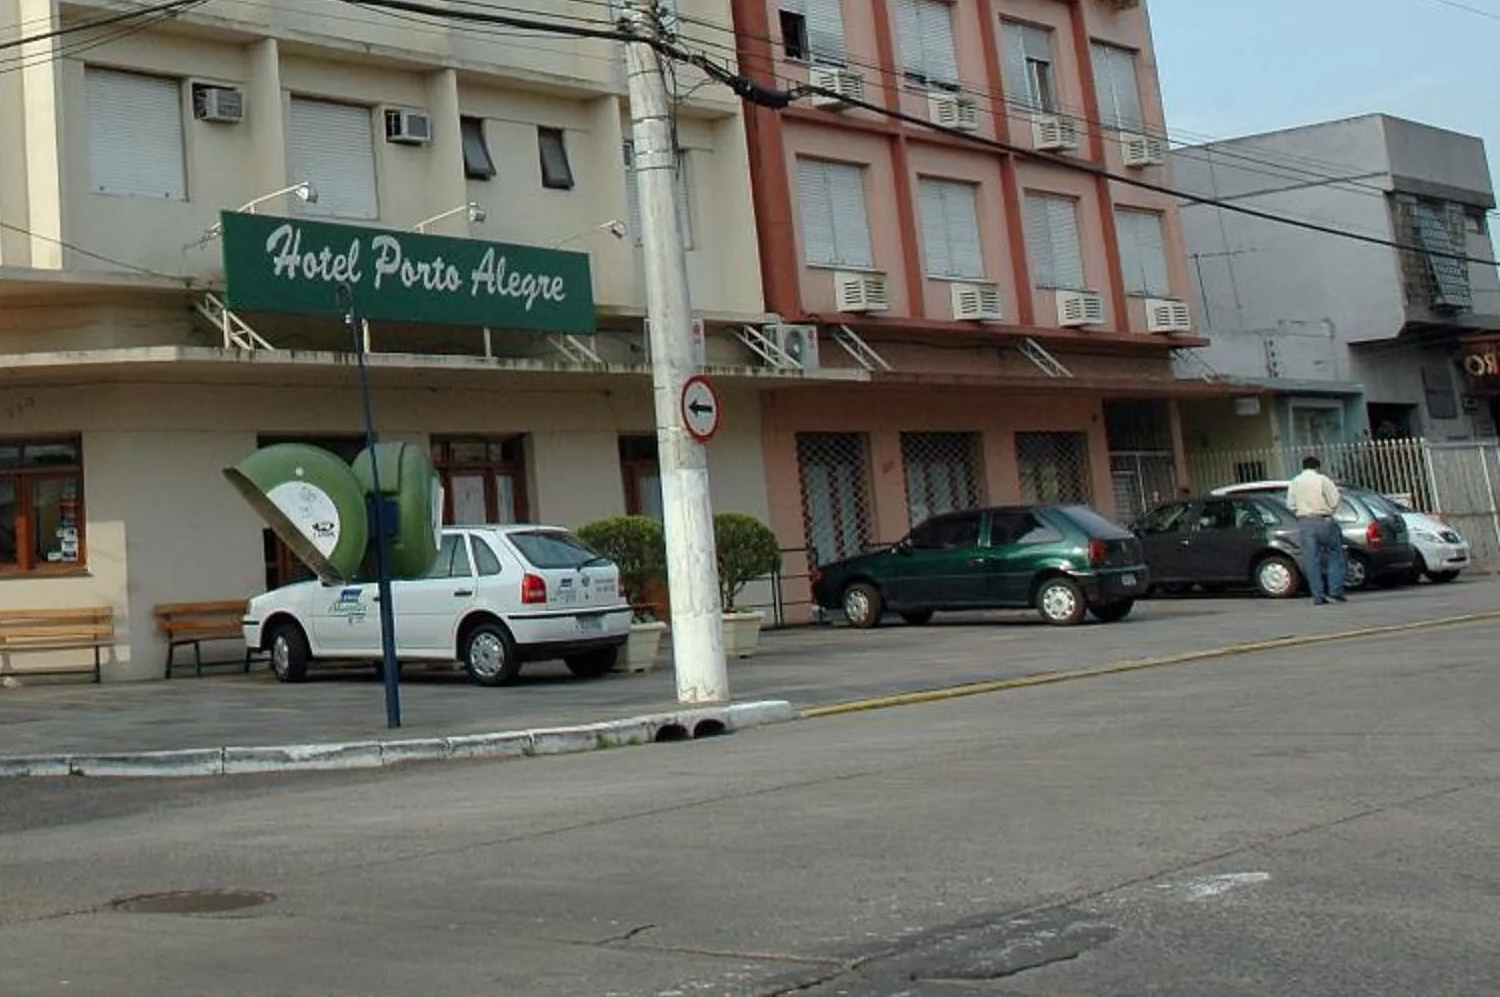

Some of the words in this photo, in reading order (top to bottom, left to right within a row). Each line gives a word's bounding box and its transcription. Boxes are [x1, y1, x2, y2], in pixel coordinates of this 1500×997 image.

[265, 223, 362, 283] Hotel
[371, 234, 463, 290] Porto
[471, 247, 566, 311] Alegre
